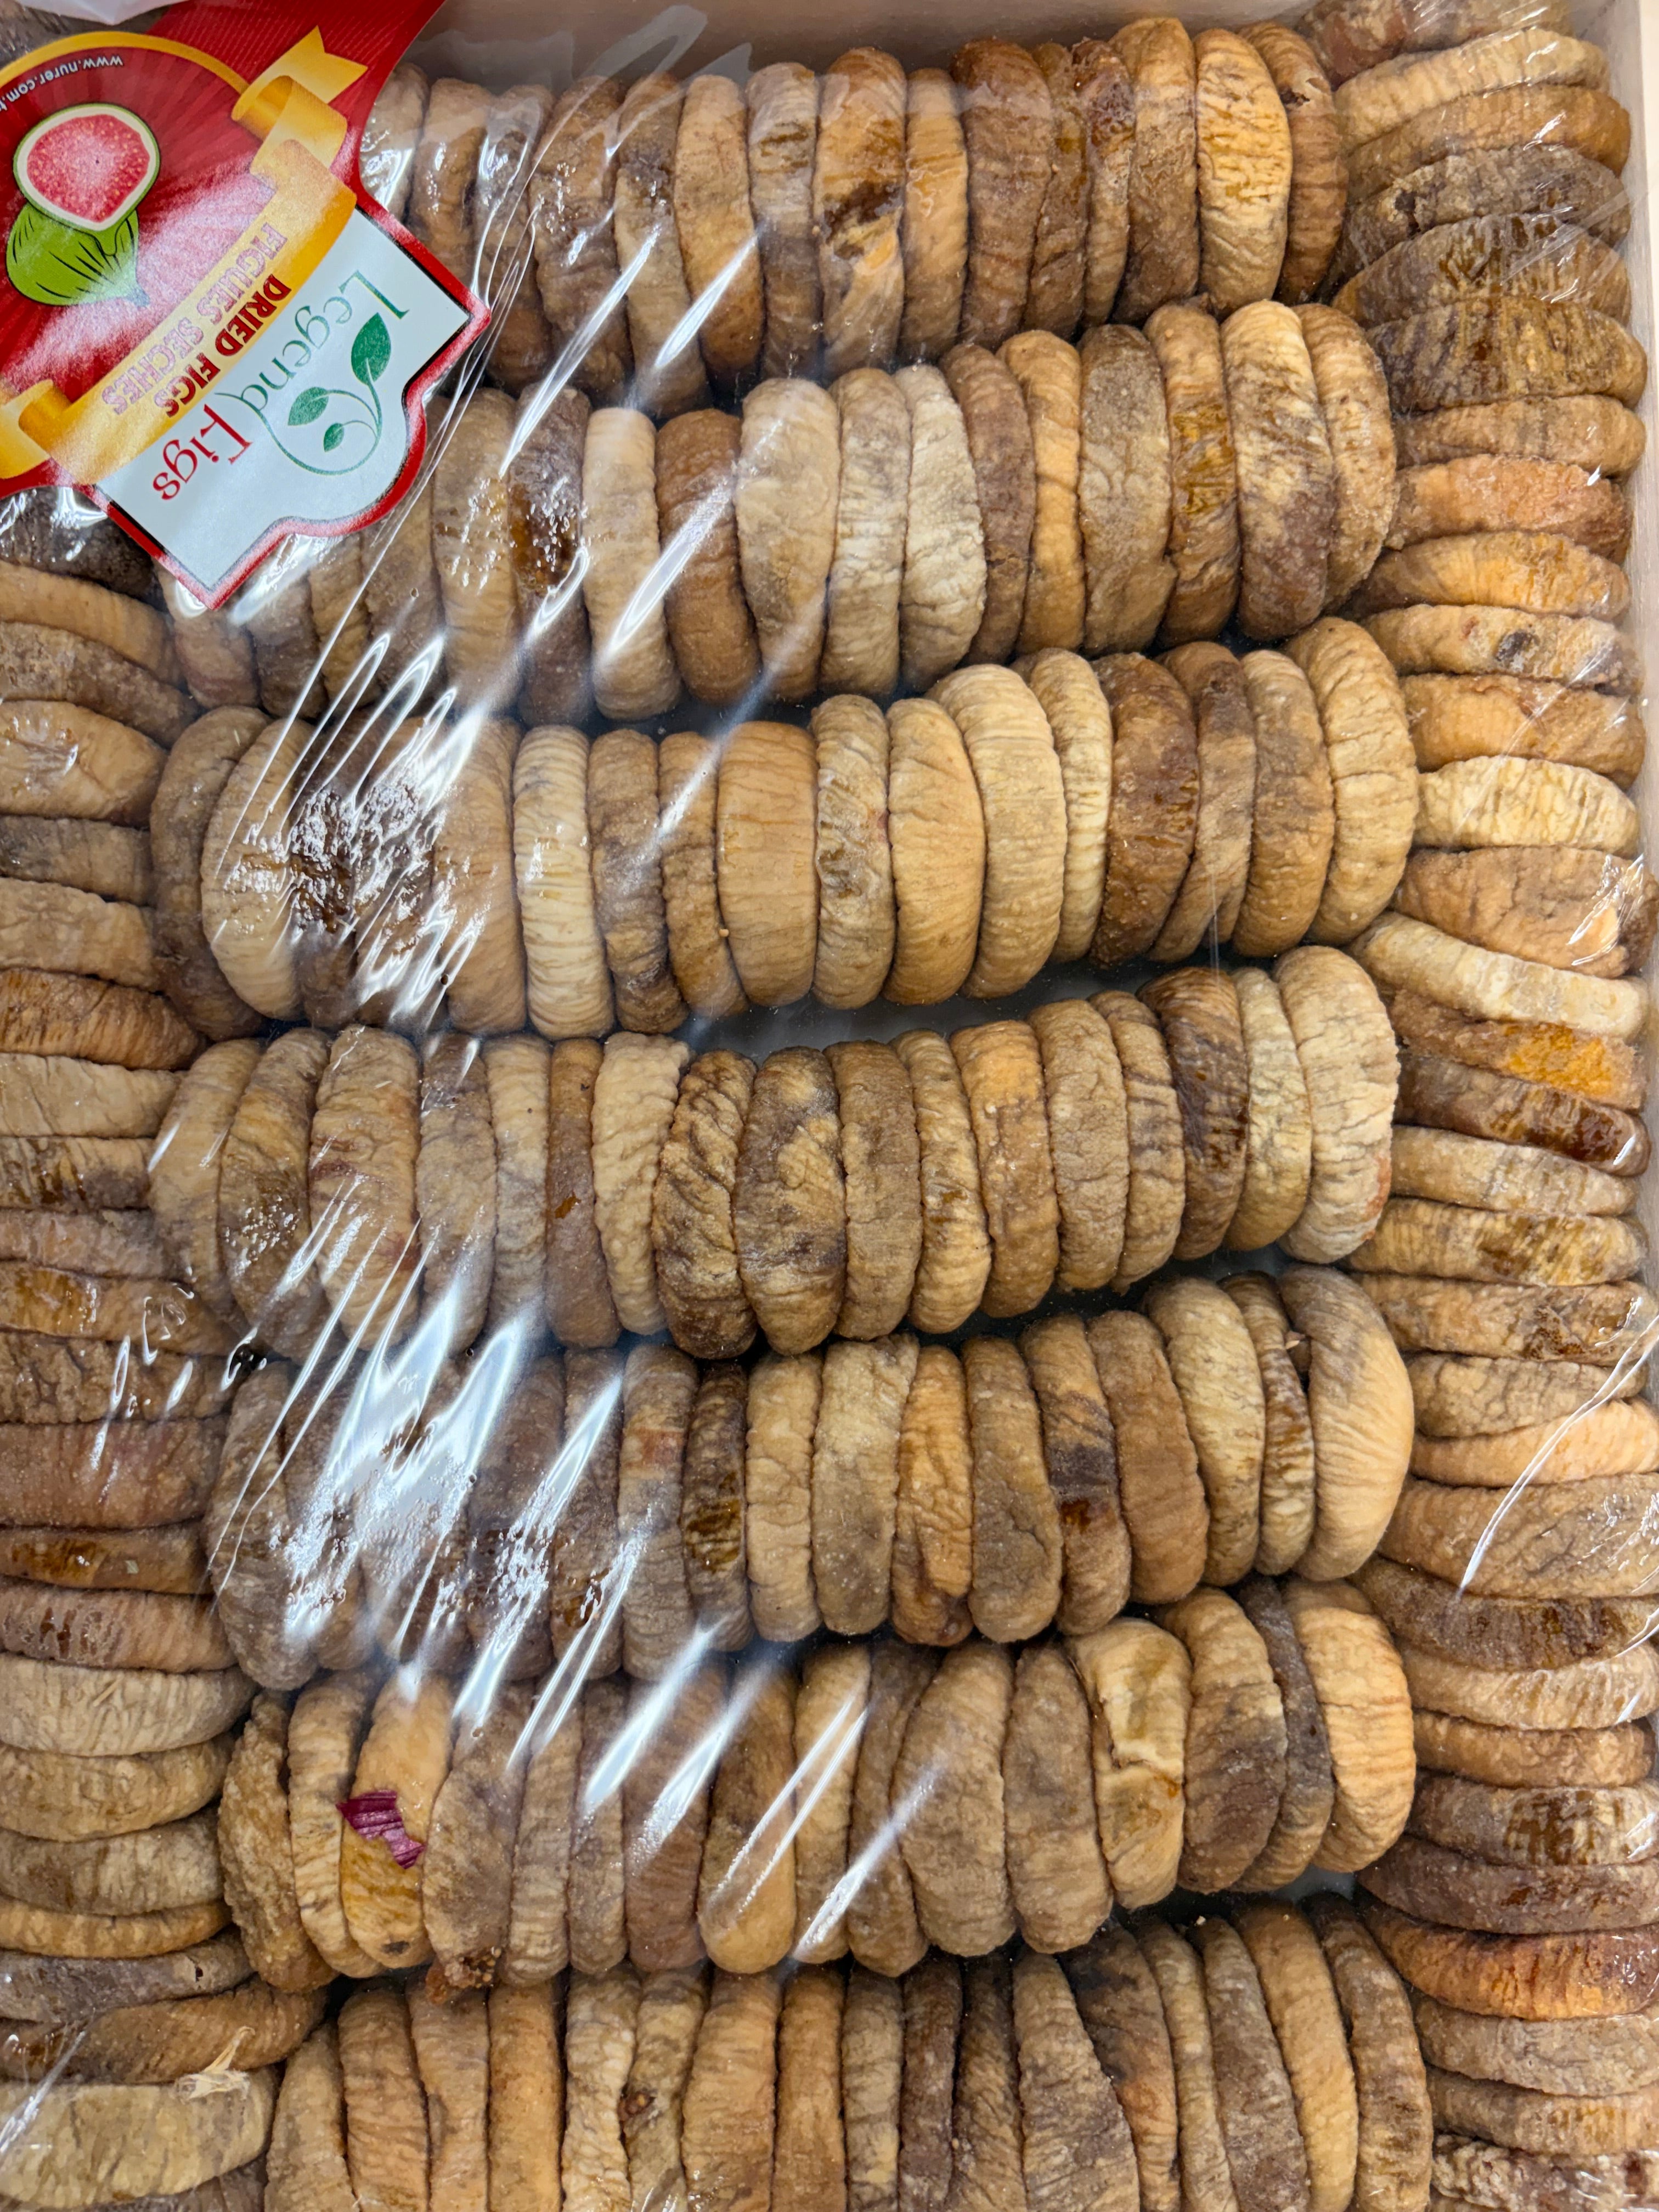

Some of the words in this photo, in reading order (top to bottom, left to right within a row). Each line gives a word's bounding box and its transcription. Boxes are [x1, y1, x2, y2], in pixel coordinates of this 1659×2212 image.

[0, 55, 124, 111] www.nurer.com.t
[196, 222, 287, 325] FIGUES
[215, 274, 291, 357] DRIED
[101, 317, 204, 415] SECHES
[154, 352, 221, 418] FIGS
[215, 269, 410, 415] Legend
[153, 403, 252, 500] Figs
